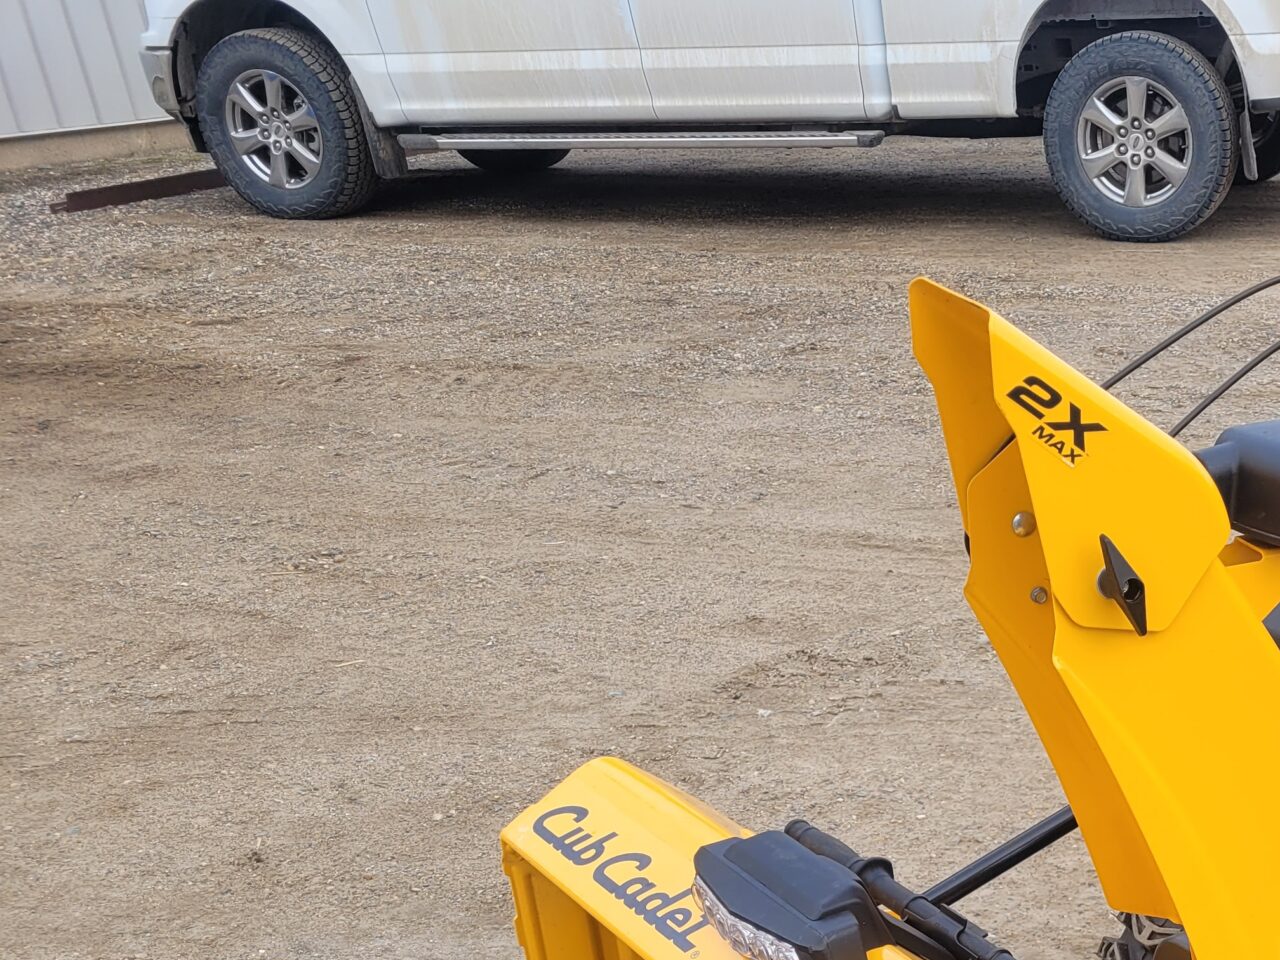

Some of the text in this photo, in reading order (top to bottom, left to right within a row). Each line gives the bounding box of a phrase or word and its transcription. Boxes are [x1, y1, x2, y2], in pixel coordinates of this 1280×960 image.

[1006, 375, 1109, 453] 2X
[1031, 425, 1083, 465] MAX
[533, 805, 712, 954] Cub Cadet
